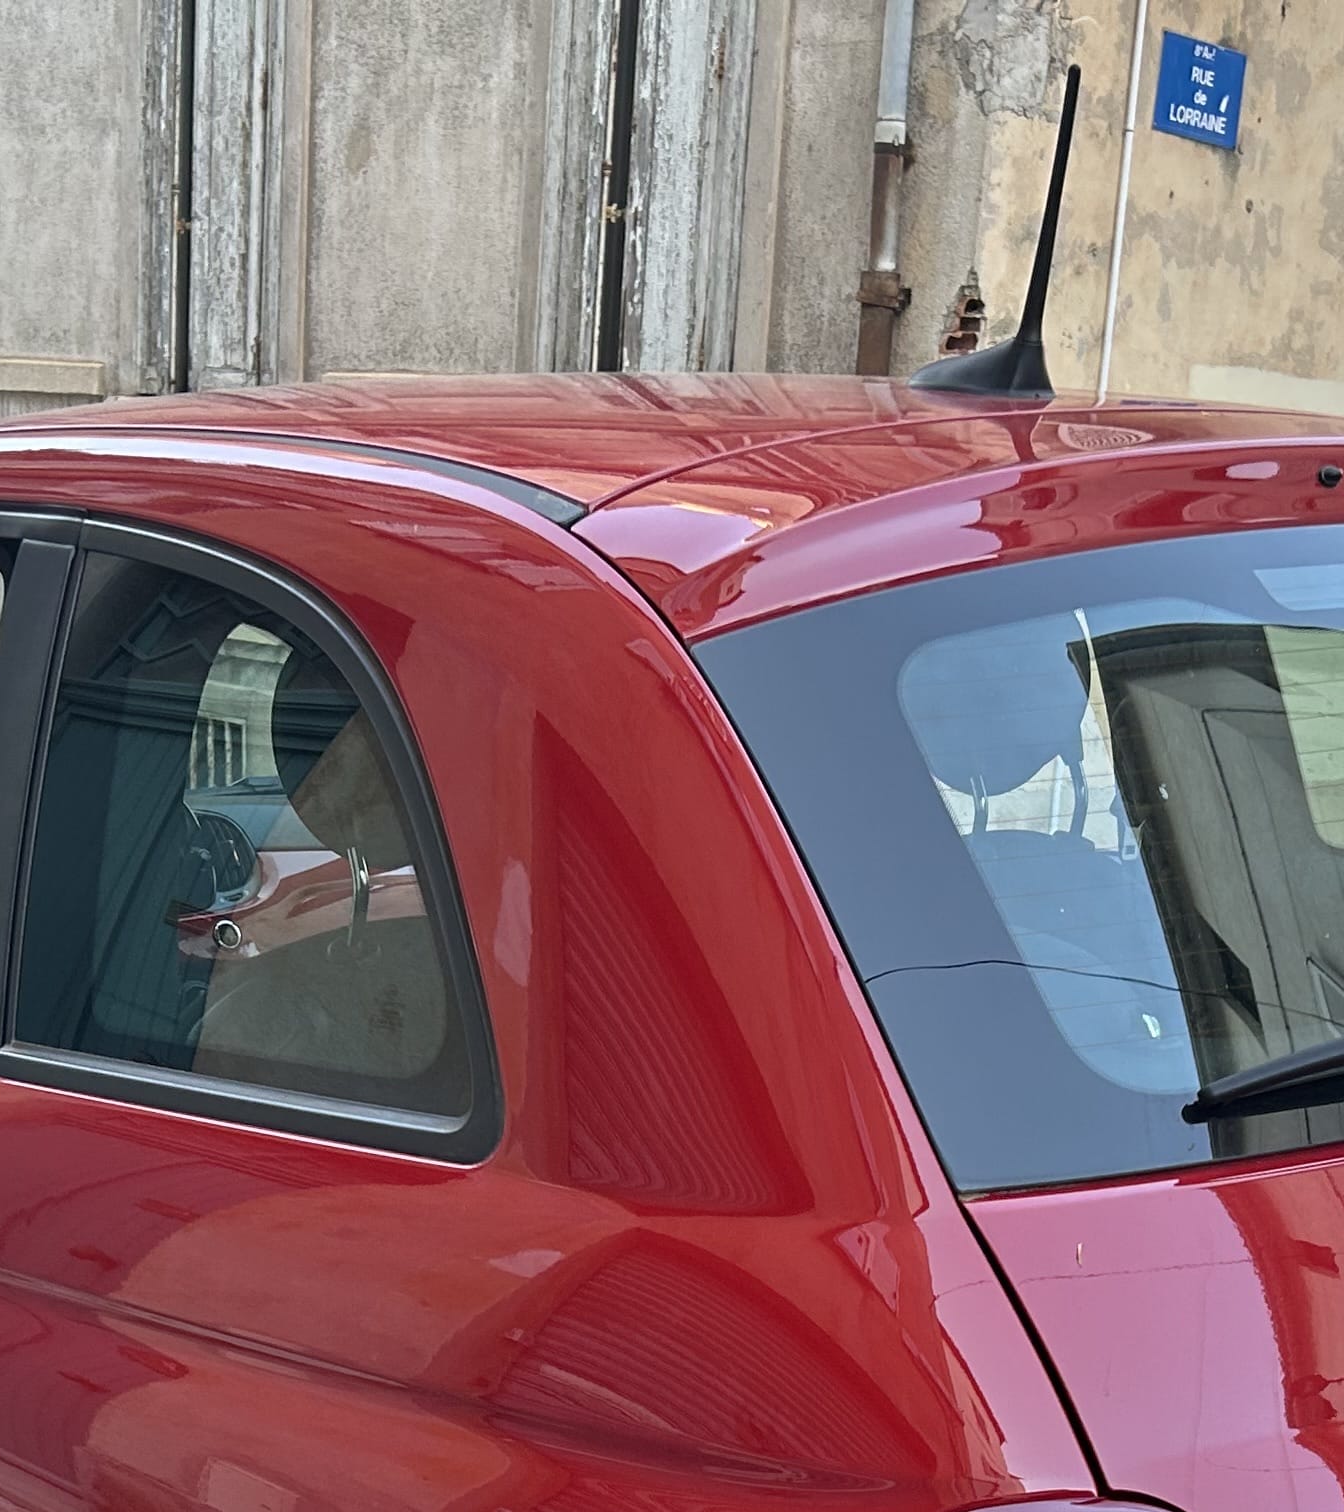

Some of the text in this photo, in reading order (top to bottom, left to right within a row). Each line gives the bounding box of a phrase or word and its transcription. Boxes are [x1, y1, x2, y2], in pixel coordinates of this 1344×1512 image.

[1191, 66, 1215, 87] RUE
[1193, 90, 1207, 105] de
[1169, 104, 1227, 134] LORRAINE
